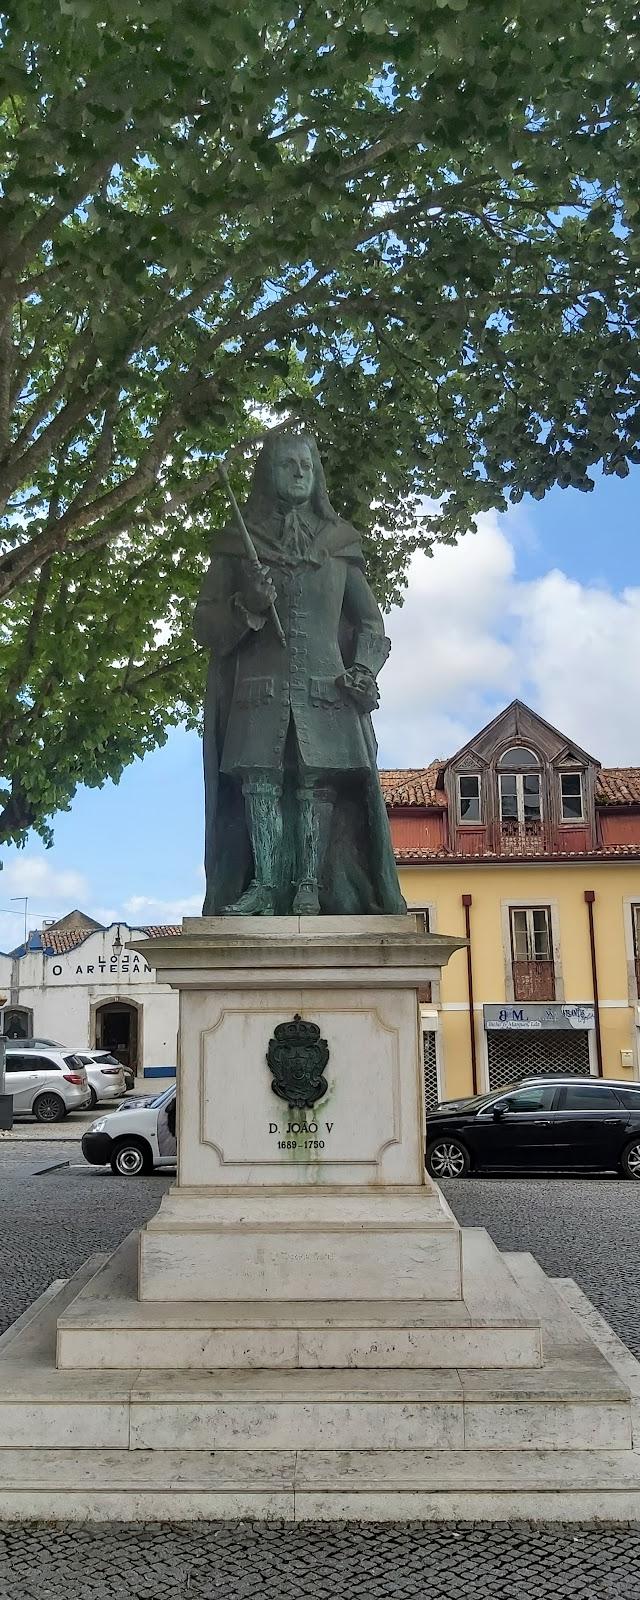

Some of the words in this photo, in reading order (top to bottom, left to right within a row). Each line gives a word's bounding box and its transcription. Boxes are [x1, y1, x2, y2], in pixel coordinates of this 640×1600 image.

[98, 955, 140, 964] LOJA
[269, 1122, 280, 1134] D.
[286, 1120, 318, 1134] JOÃO
[325, 1122, 334, 1134] V
